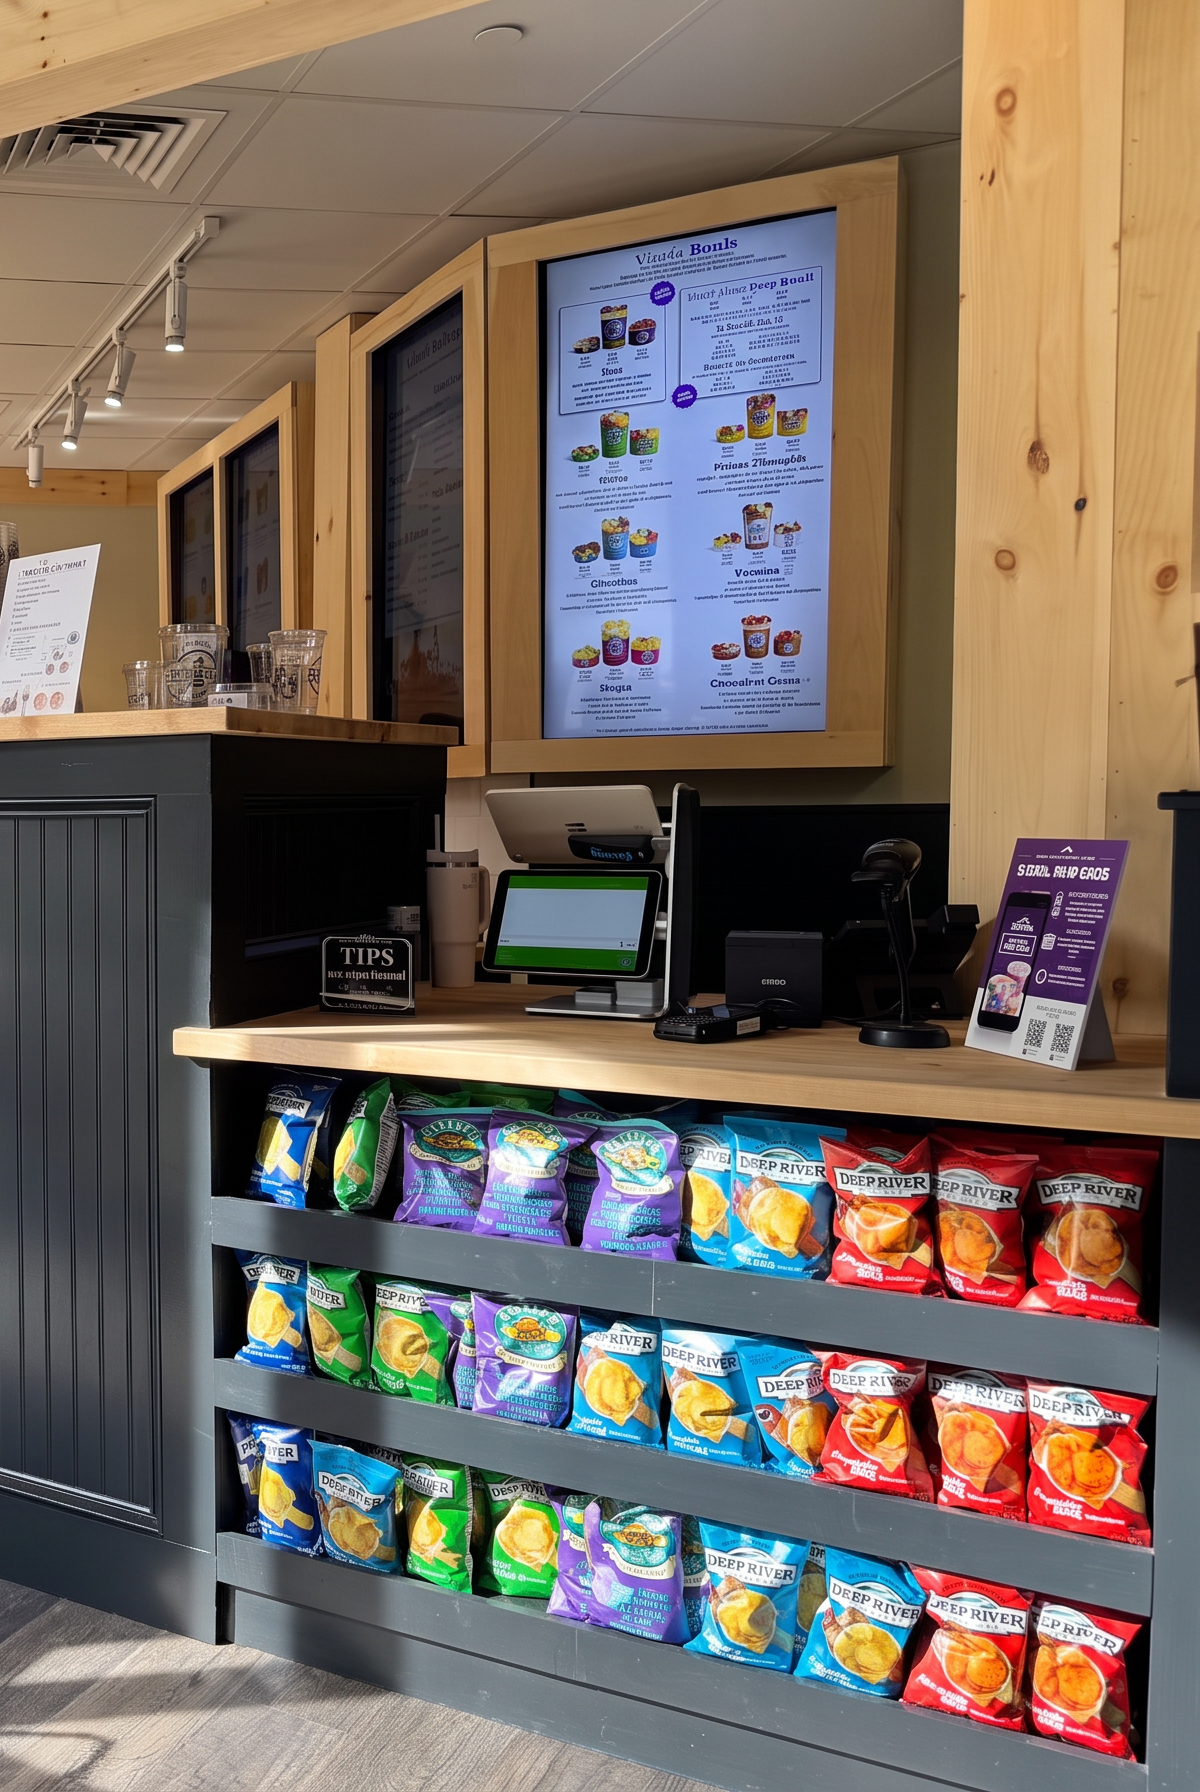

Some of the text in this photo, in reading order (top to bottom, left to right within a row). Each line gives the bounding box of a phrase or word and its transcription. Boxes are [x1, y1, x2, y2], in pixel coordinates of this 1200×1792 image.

[340, 947, 394, 966] TIPS
[780, 1163, 826, 1178] RIVER
[839, 1172, 928, 1189] DEEP RIVER
[934, 1178, 1013, 1204] EEP RIVER
[1040, 1182, 1137, 1204] DEEP RIVER
[376, 1287, 397, 1300] EEP
[609, 1333, 653, 1350] RIVER
[662, 1345, 737, 1370] DEEP RIVER
[762, 1379, 805, 1393] DEEP
[832, 1372, 866, 1387] DEEP
[976, 1384, 1025, 1408] RIVER
[1032, 1393, 1072, 1414] DEEP
[707, 1554, 793, 1581] DEEP RIVER
[831, 1582, 920, 1620] DEEP RIVER
[970, 1609, 1025, 1630] RIVER
[1063, 1623, 1117, 1654] RIVER
